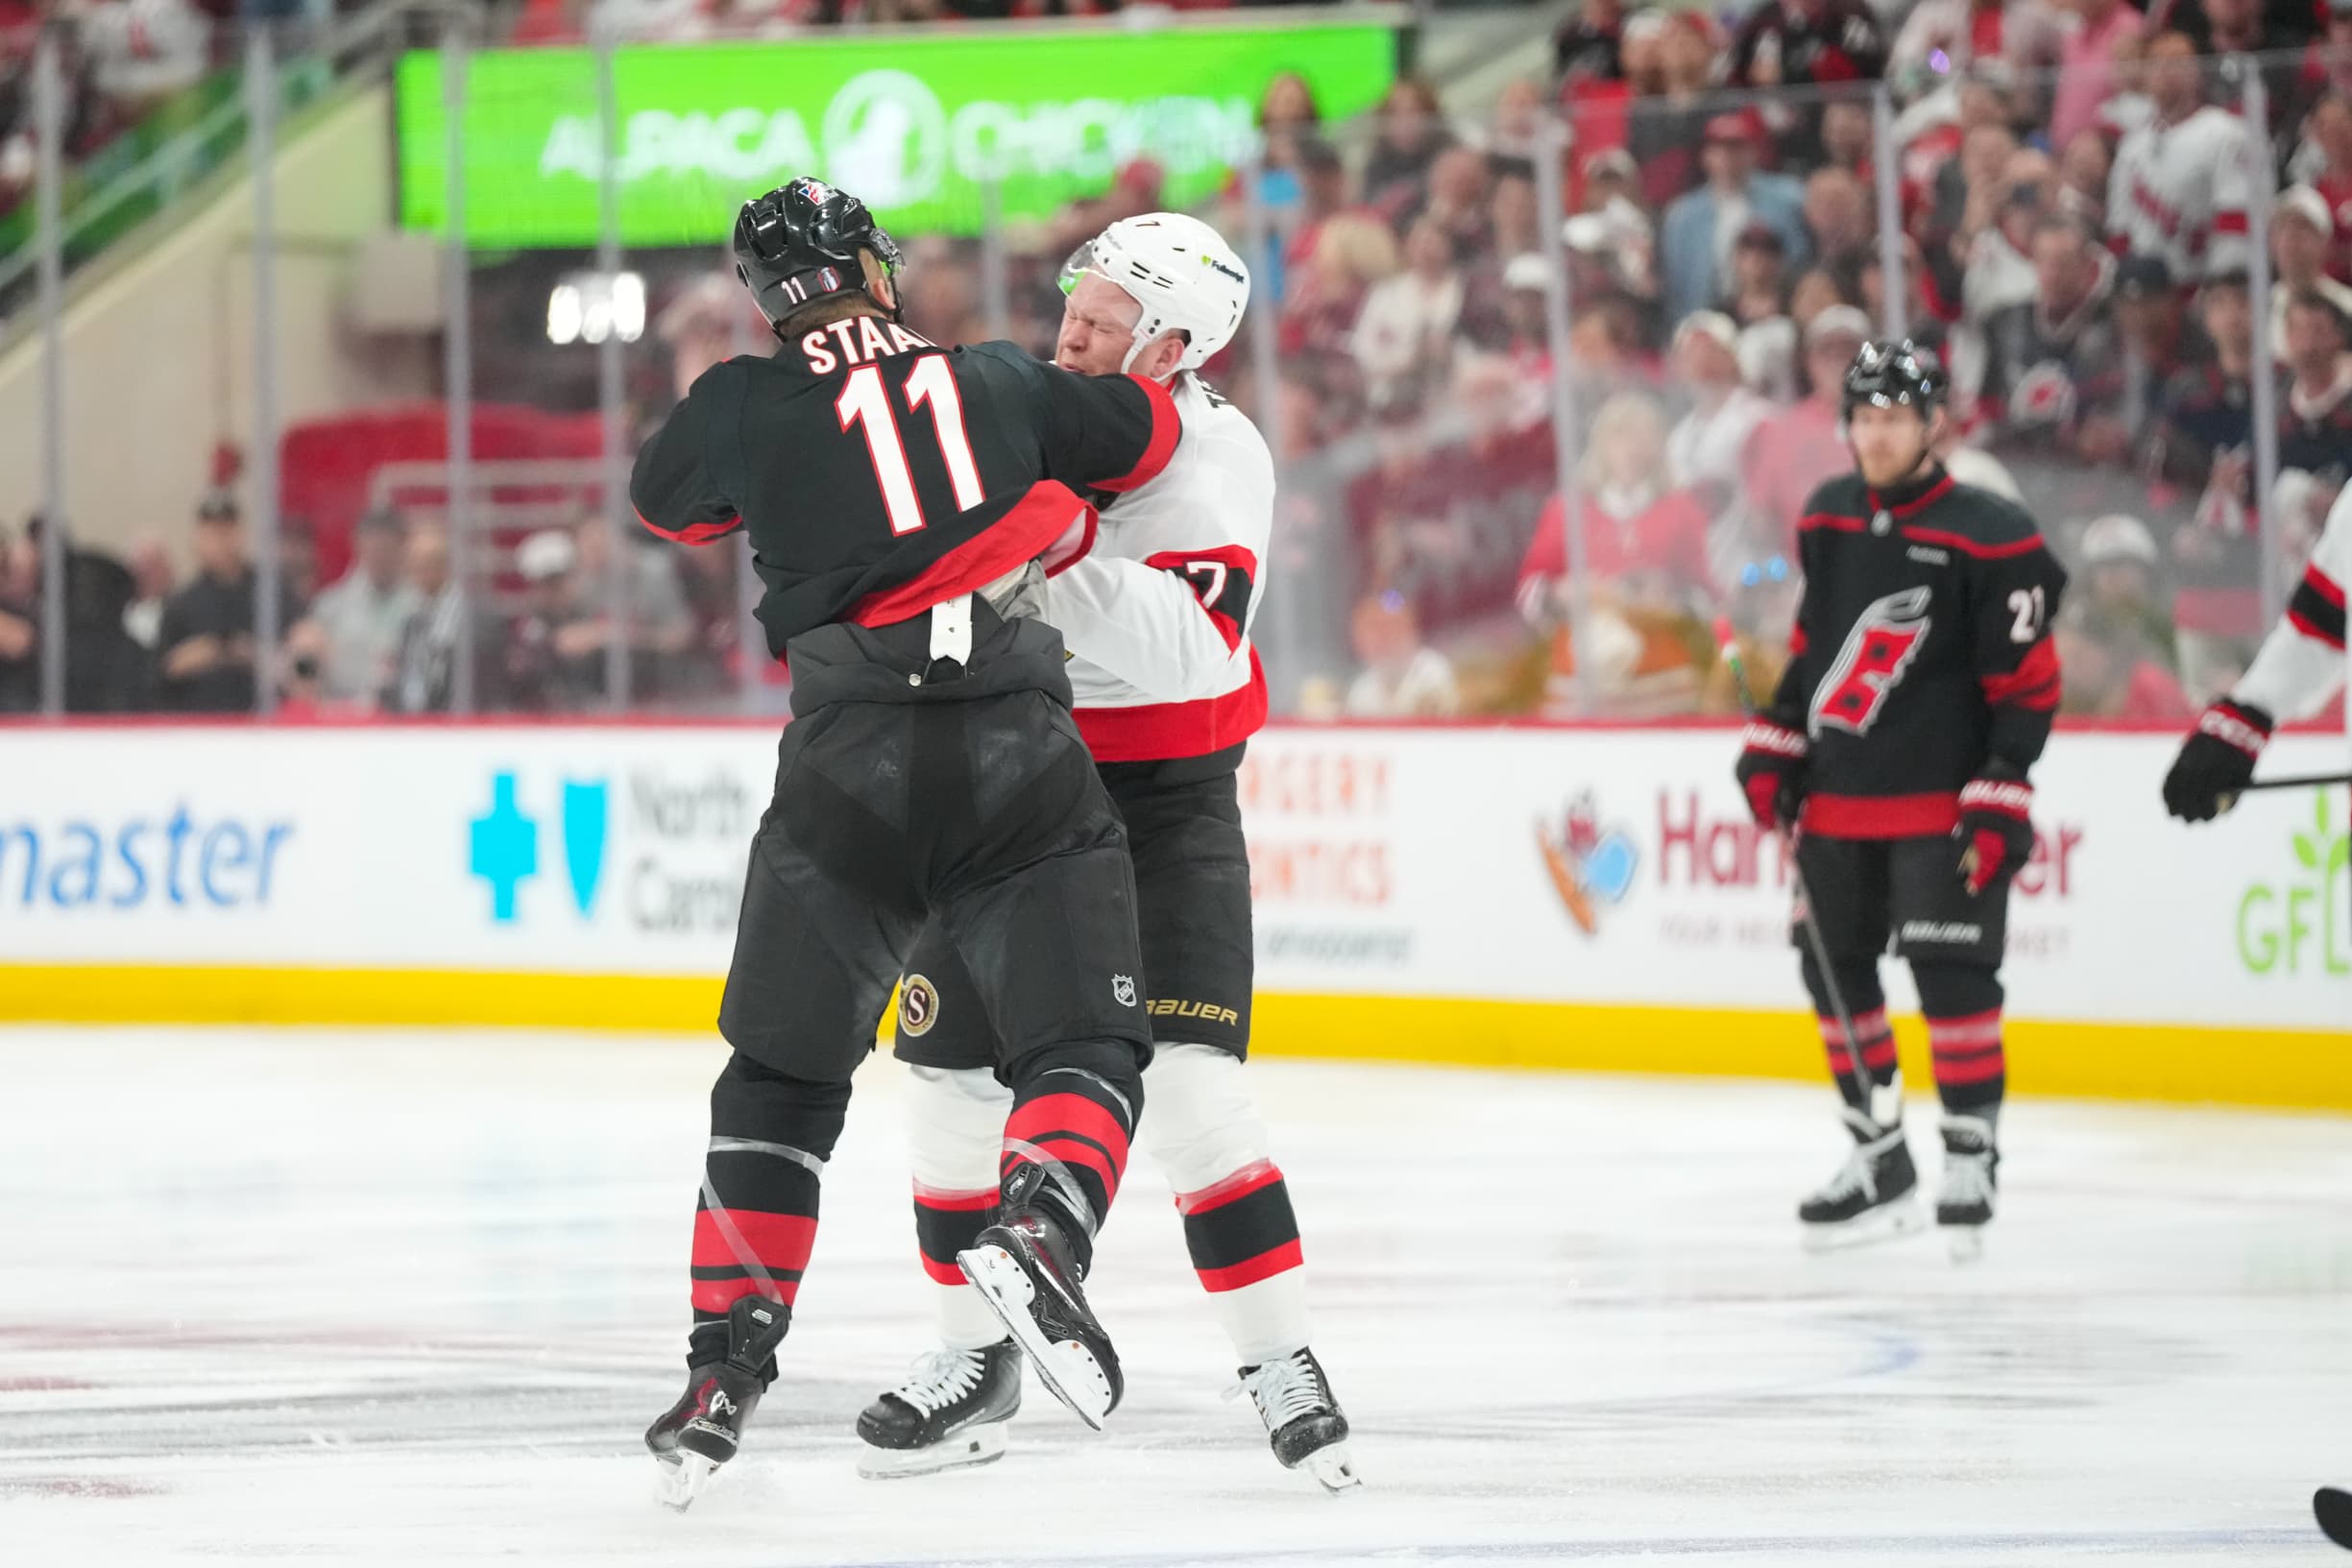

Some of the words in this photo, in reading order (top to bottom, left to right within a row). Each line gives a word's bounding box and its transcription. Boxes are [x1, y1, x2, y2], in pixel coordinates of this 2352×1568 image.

[781, 276, 808, 304] 11
[801, 315, 937, 374] STAA
[834, 352, 987, 538] 11
[1184, 560, 1227, 612] 7
